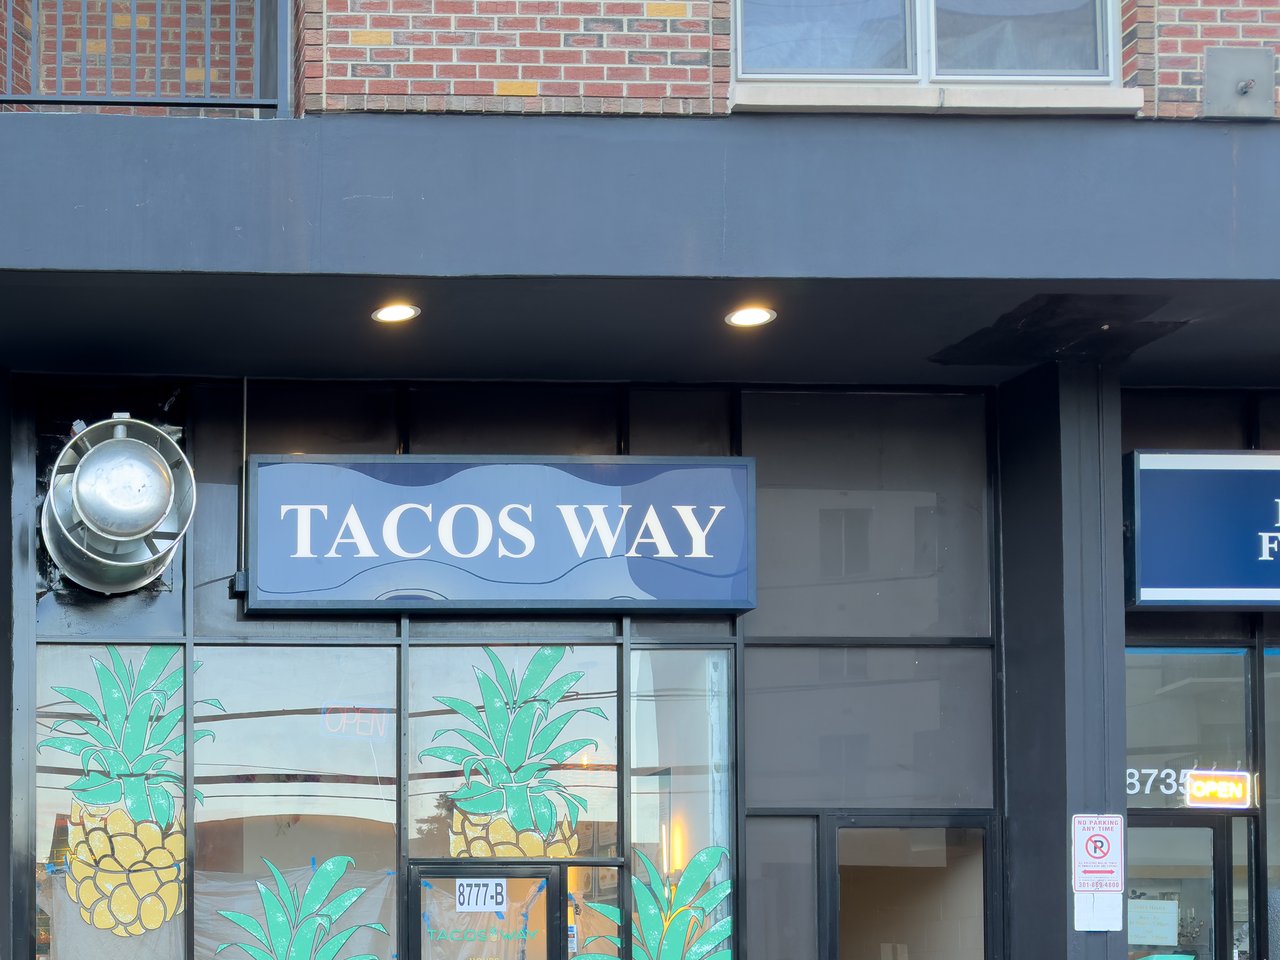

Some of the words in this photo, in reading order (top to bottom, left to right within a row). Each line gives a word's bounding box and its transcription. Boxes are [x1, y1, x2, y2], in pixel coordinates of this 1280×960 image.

[280, 502, 535, 558] TACOS
[556, 503, 726, 558] WAY
[325, 705, 387, 736] OPEN
[1194, 781, 1243, 798] OPEN
[458, 882, 505, 907] 8777-B
[427, 929, 488, 941] TACOS
[500, 929, 539, 940] WAY
